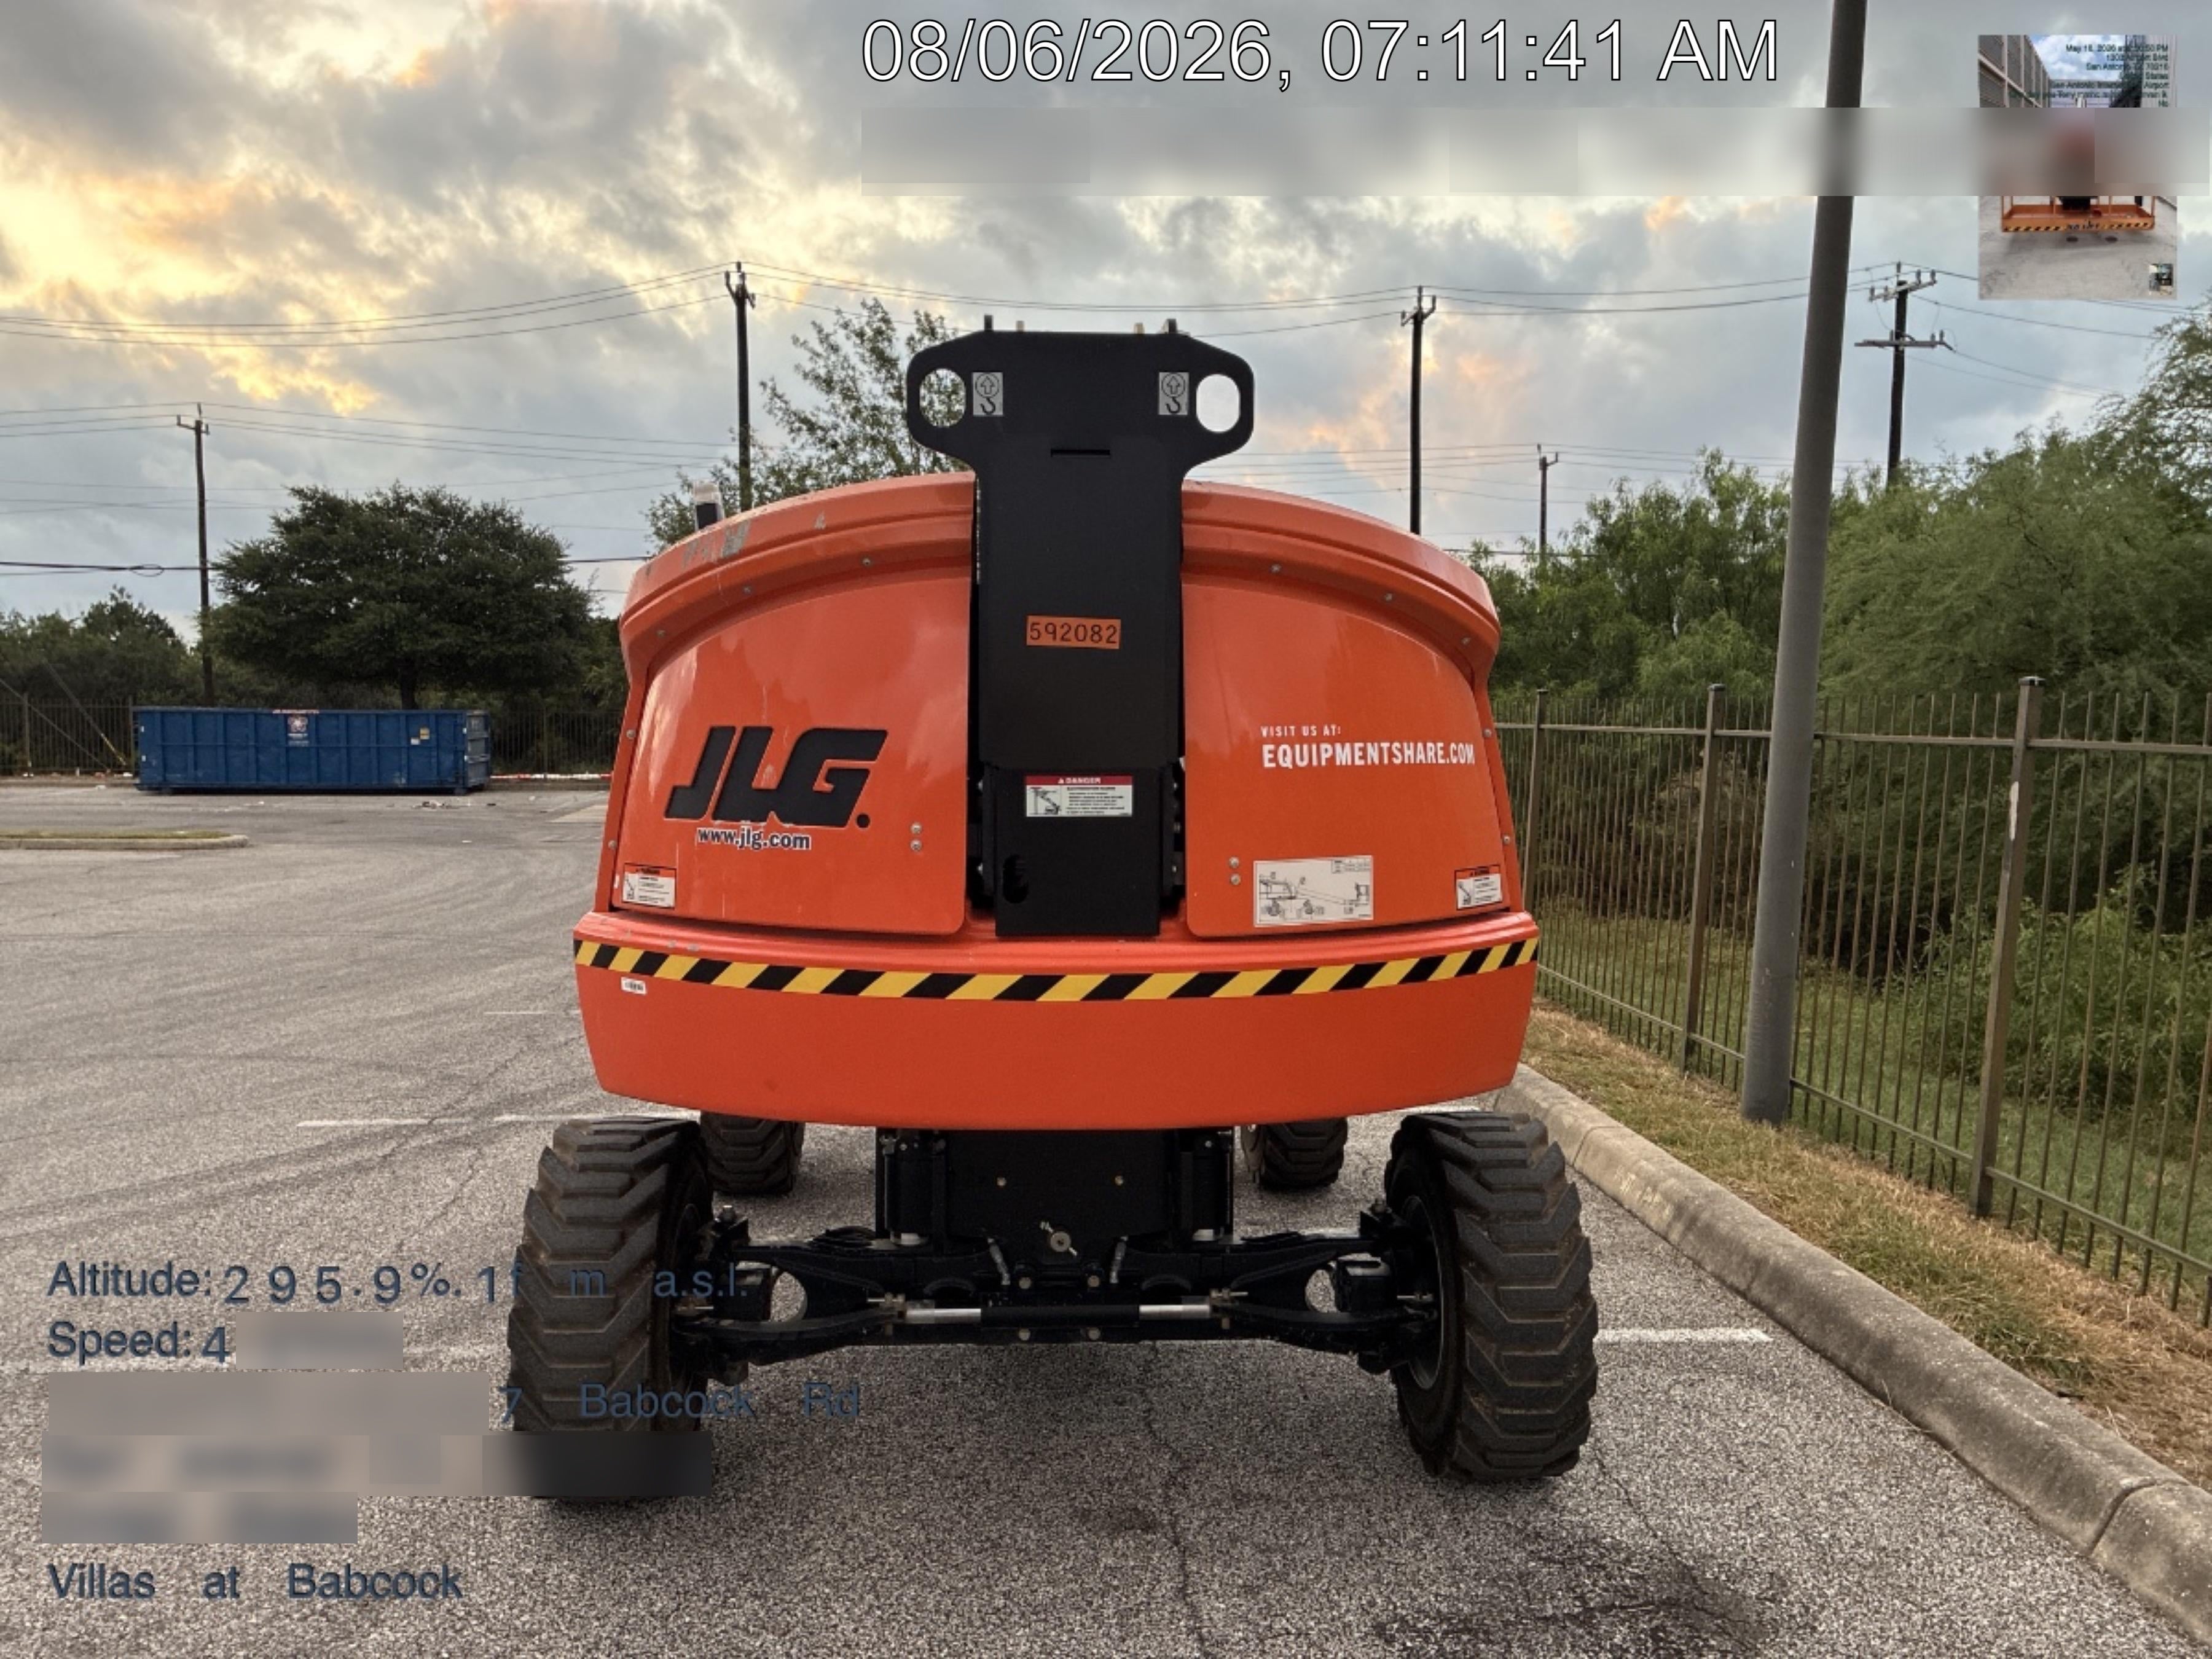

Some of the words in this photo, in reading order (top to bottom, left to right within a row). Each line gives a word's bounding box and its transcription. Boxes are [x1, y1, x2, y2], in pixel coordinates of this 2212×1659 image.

[1029, 621, 1117, 645] 592082
[1261, 726, 1295, 737] VISIT
[1302, 726, 1317, 736] US
[1323, 725, 1341, 736] AT:
[1262, 742, 1475, 769] EQUIPMENTSHARE.COM
[697, 828, 811, 850] www.jlg.com
